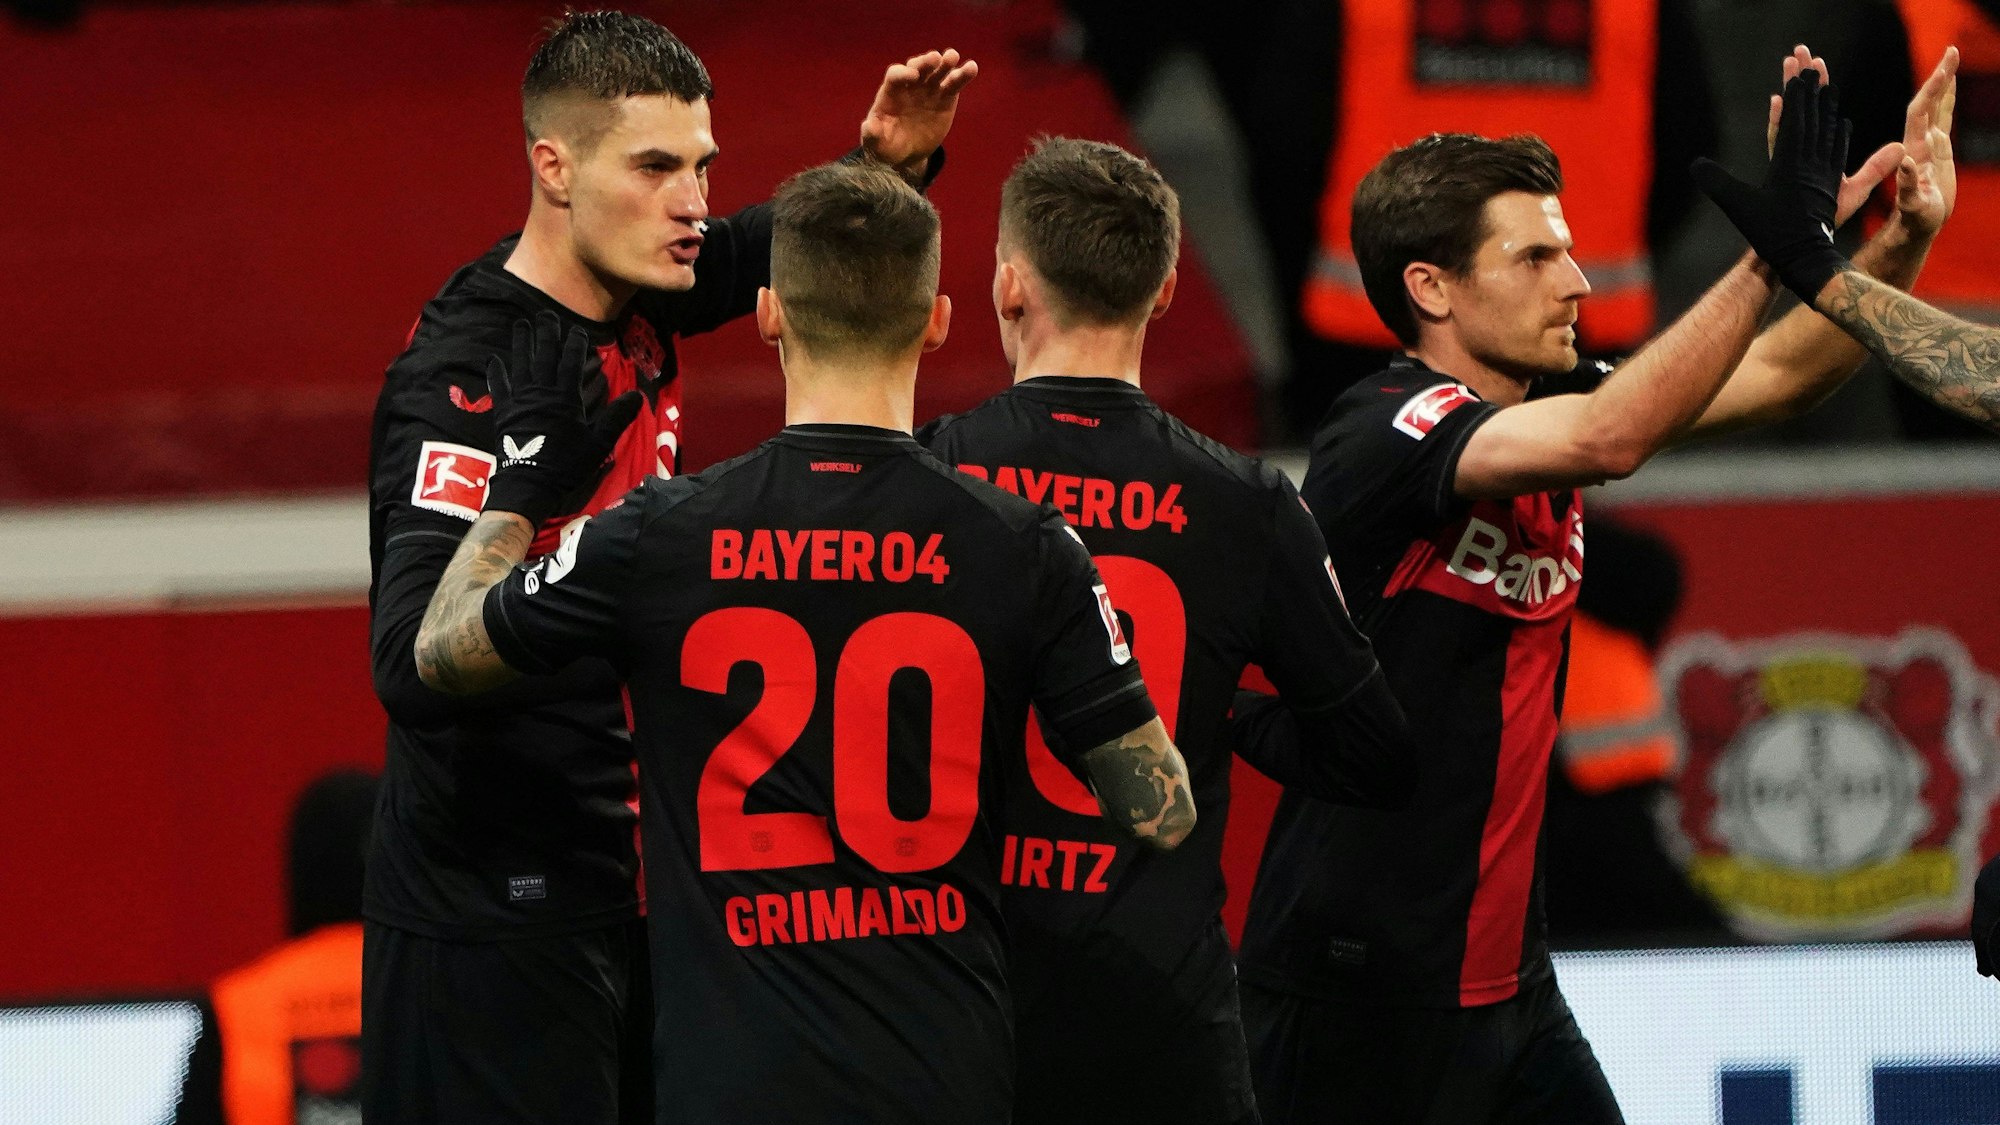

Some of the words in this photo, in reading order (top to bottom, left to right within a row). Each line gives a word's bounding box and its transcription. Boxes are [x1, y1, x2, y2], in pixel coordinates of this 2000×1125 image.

[810, 462, 863, 474] WERKSELF
[1121, 481, 1188, 534] 04
[711, 529, 875, 582] BAYER
[881, 532, 950, 584] 04
[680, 606, 986, 874] 20
[1000, 835, 1117, 893] IRTZ
[725, 883, 967, 947] GRIMALDO
